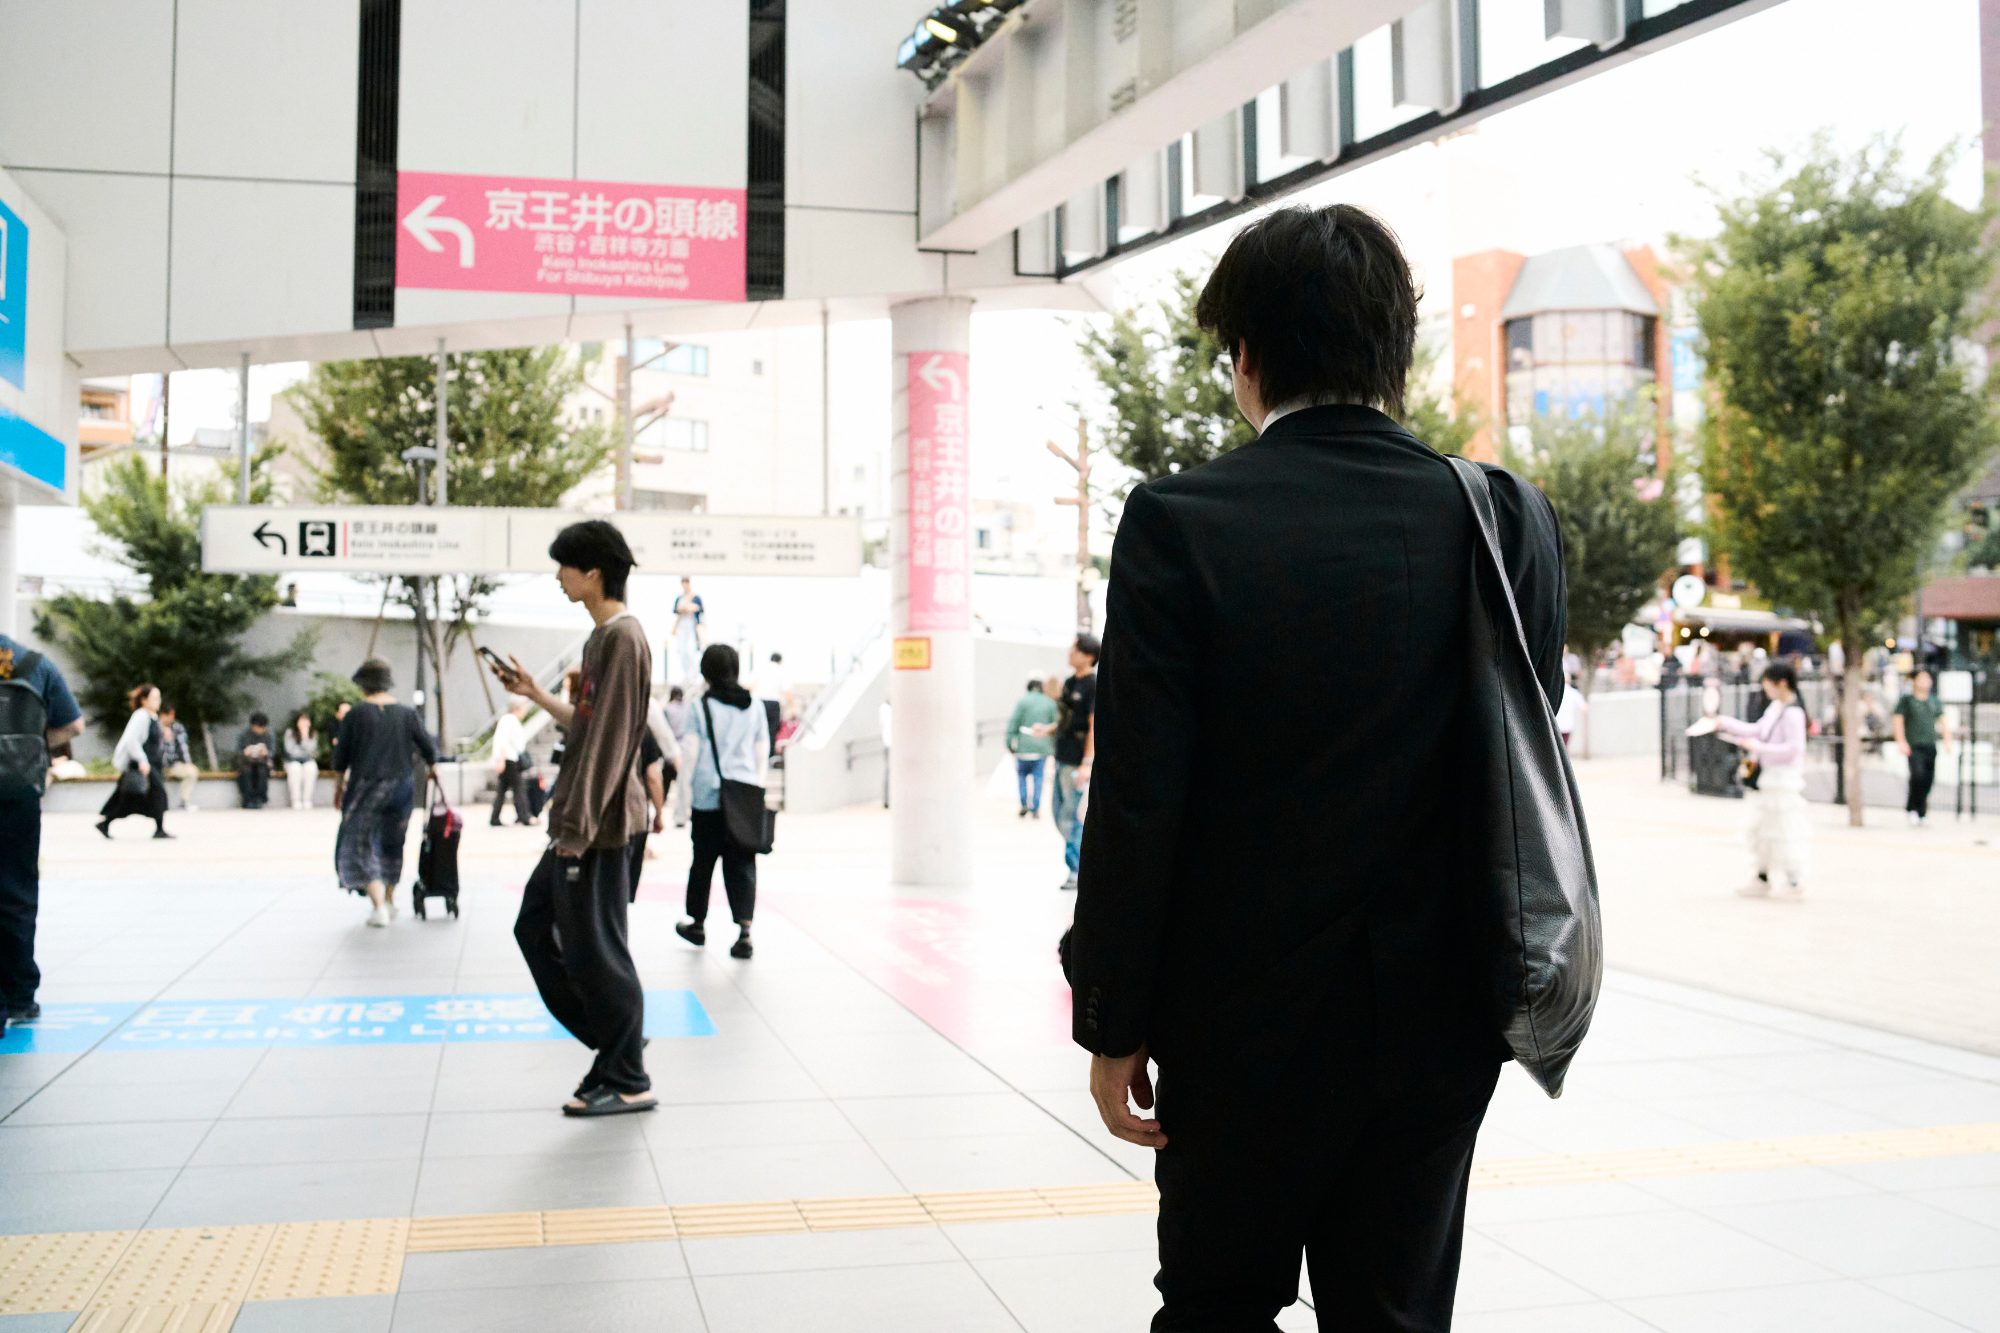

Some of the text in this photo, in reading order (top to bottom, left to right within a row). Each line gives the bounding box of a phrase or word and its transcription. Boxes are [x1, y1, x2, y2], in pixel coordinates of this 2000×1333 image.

[485, 188, 738, 241] 京王井の頭線
[932, 403, 966, 604] 京王井の頭線
[119, 1022, 548, 1043] Odakyu Line
